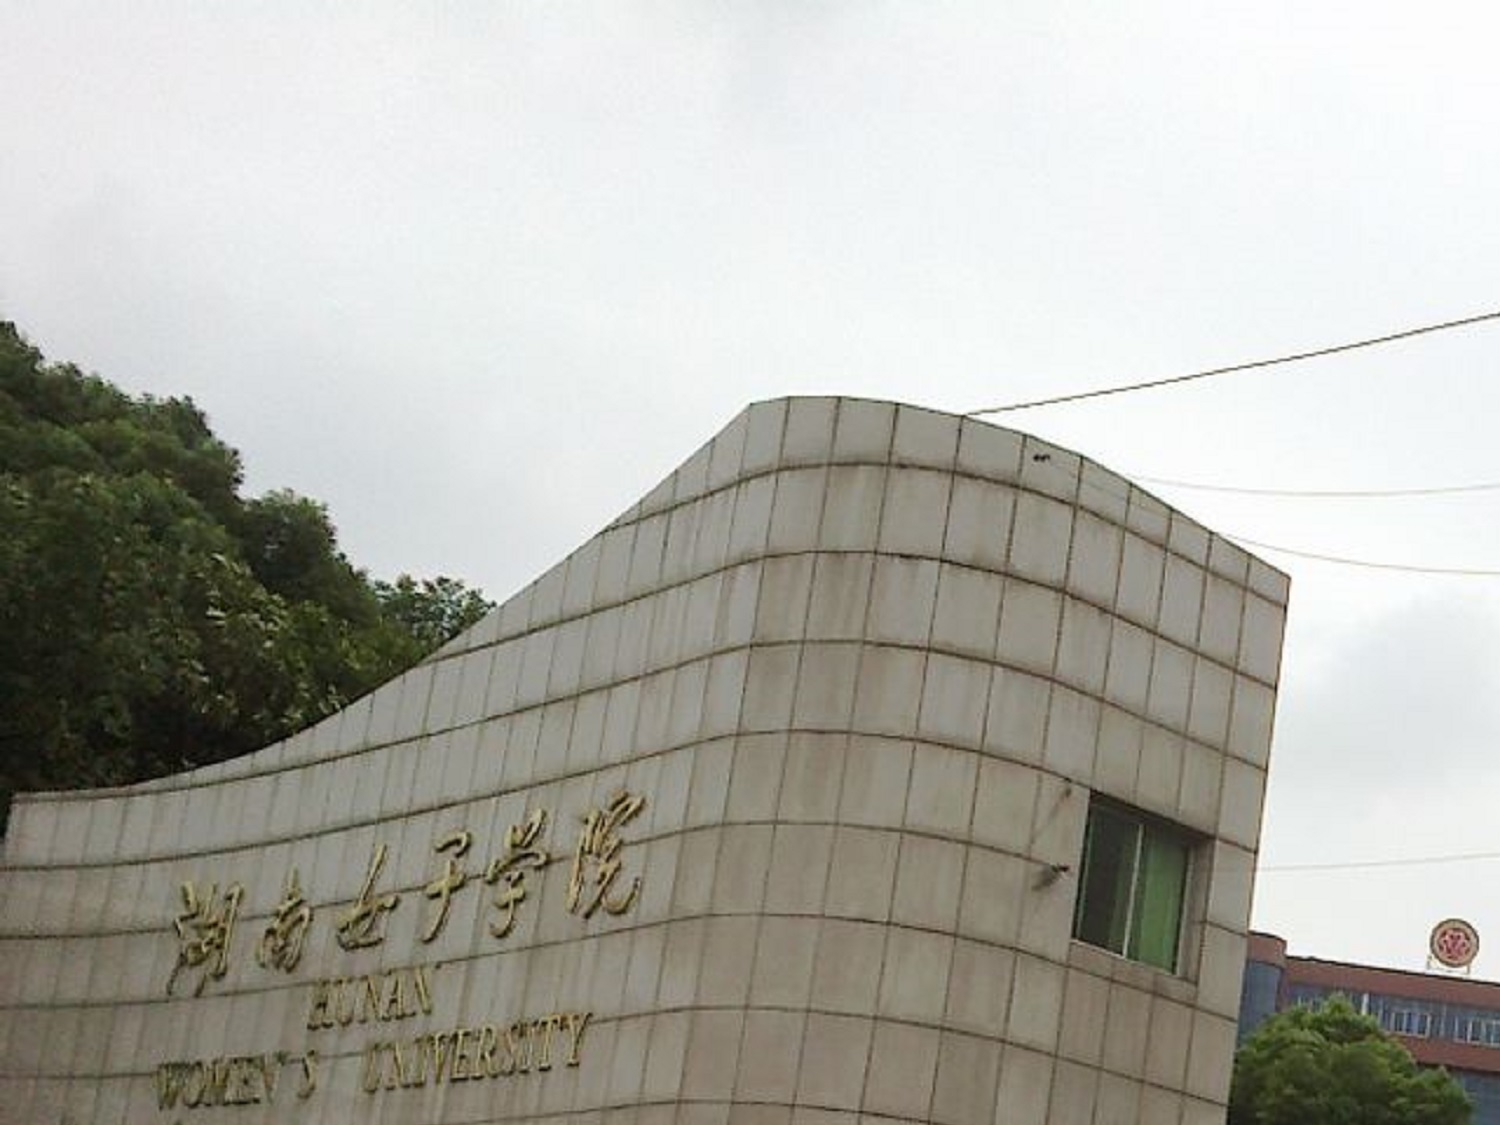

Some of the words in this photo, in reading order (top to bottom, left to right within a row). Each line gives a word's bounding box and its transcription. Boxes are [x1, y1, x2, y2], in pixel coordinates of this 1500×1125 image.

[166, 790, 646, 999] 湖南女子学院
[306, 965, 437, 1031] HUNAN
[362, 1011, 592, 1095] UNIVERSITY
